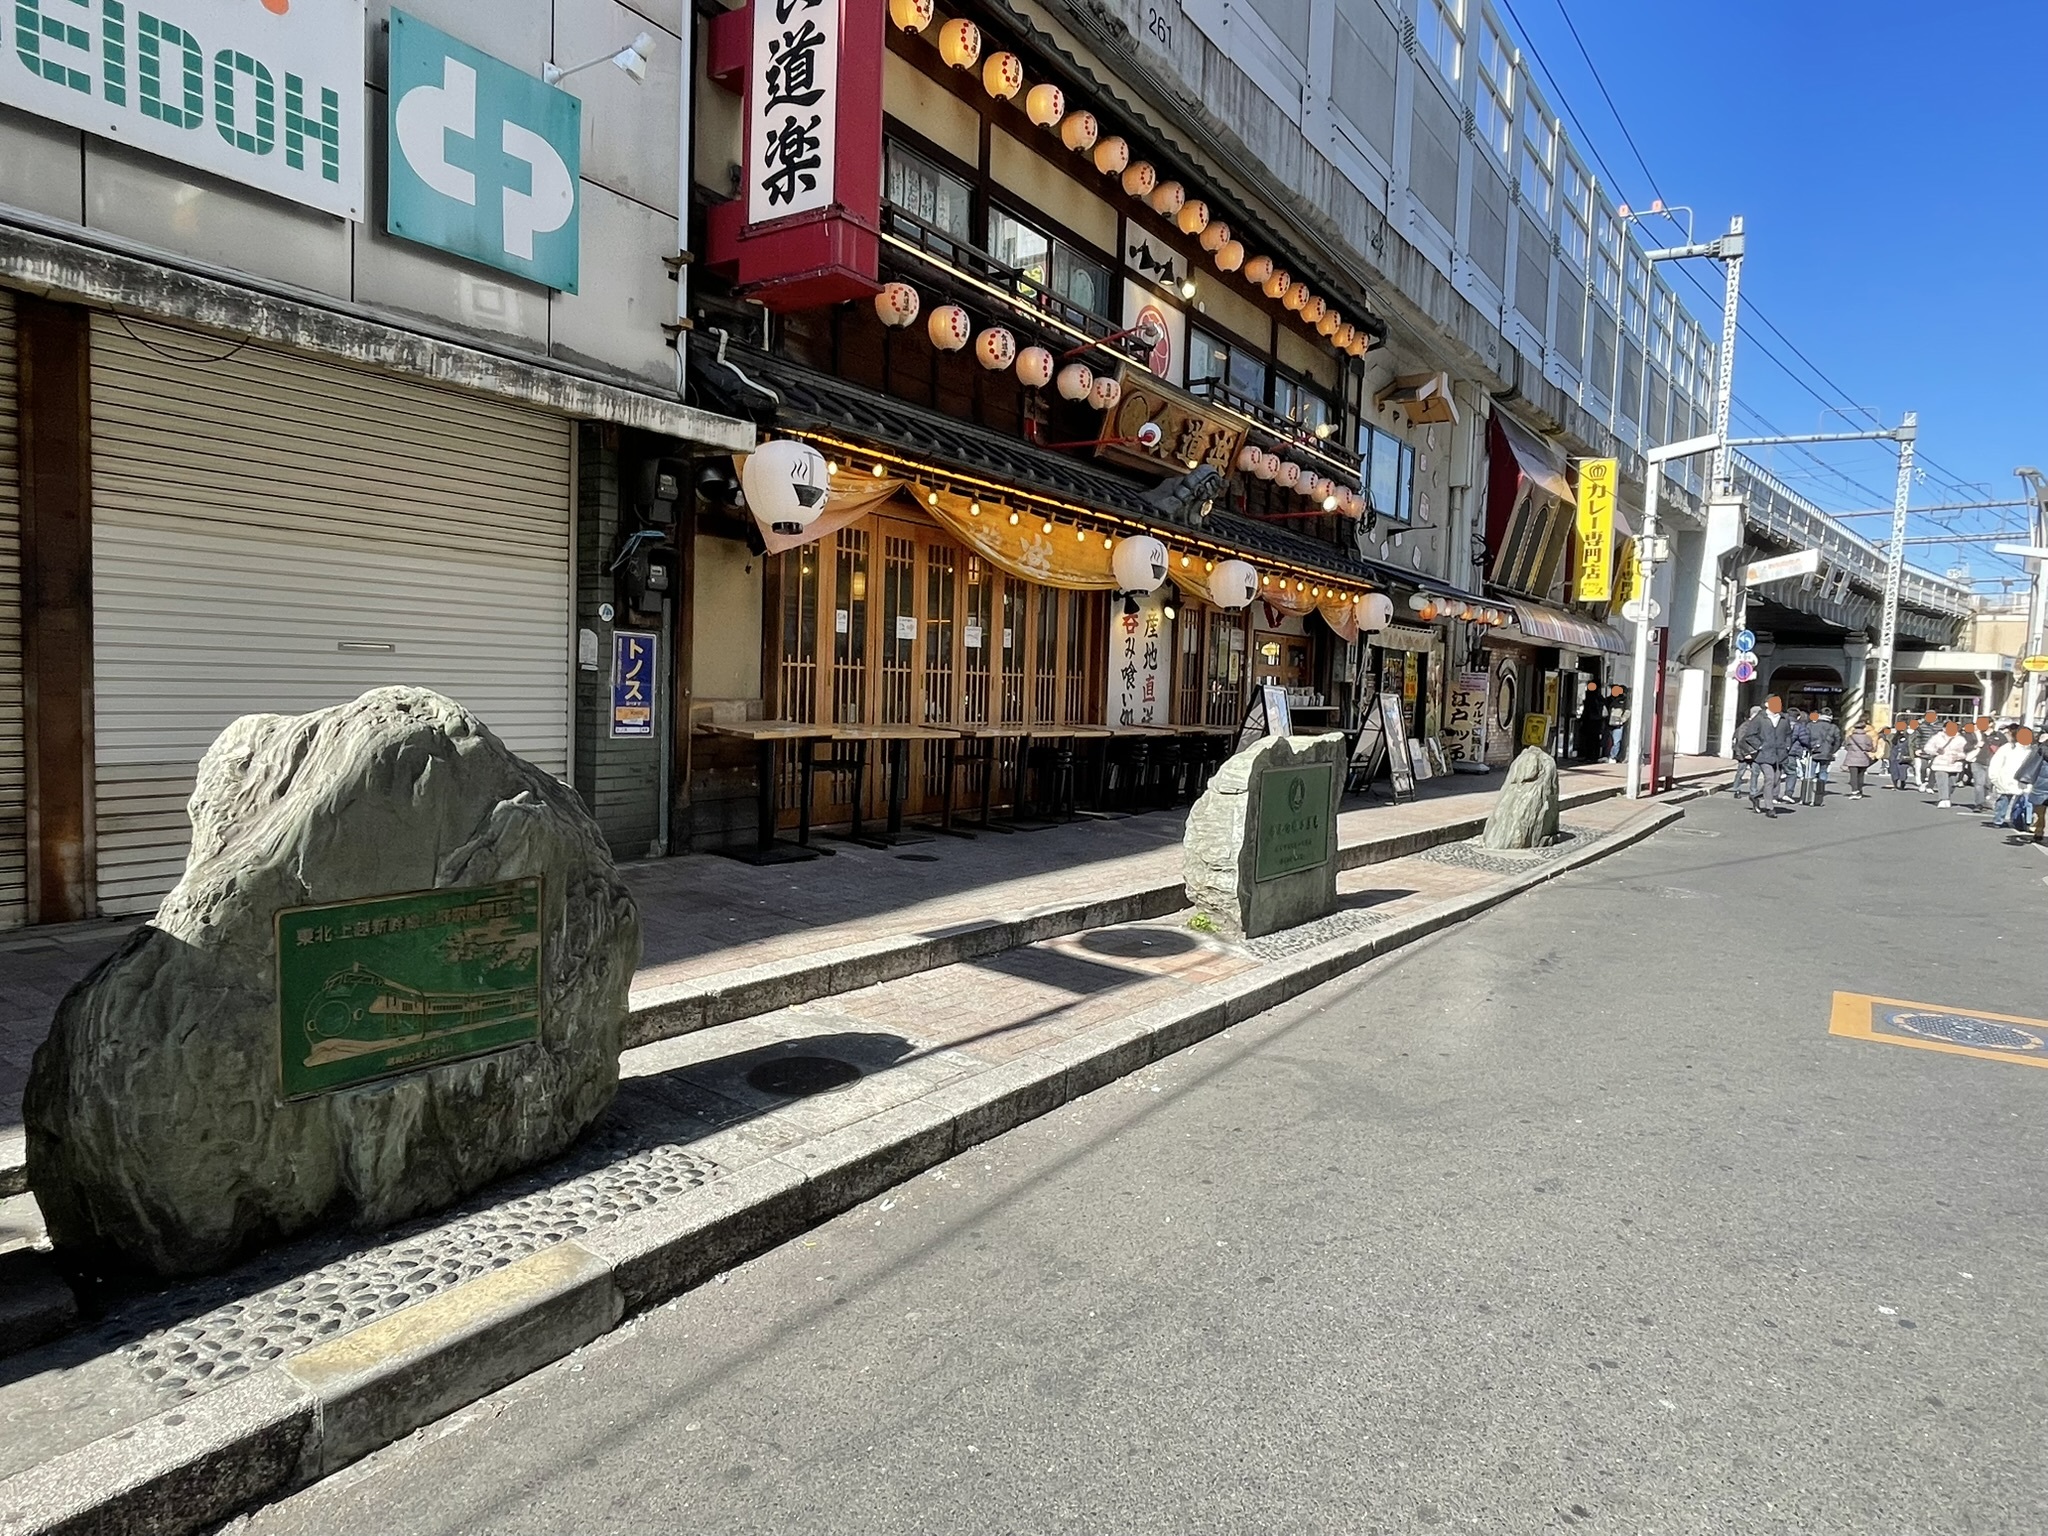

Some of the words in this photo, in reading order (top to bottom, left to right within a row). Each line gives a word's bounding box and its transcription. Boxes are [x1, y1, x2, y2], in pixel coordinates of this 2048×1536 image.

[1149, 8, 1171, 49] 261
[0, 0, 338, 183] EIDOH
[1584, 483, 1607, 580] カレー専門店
[625, 638, 643, 700] トノス
